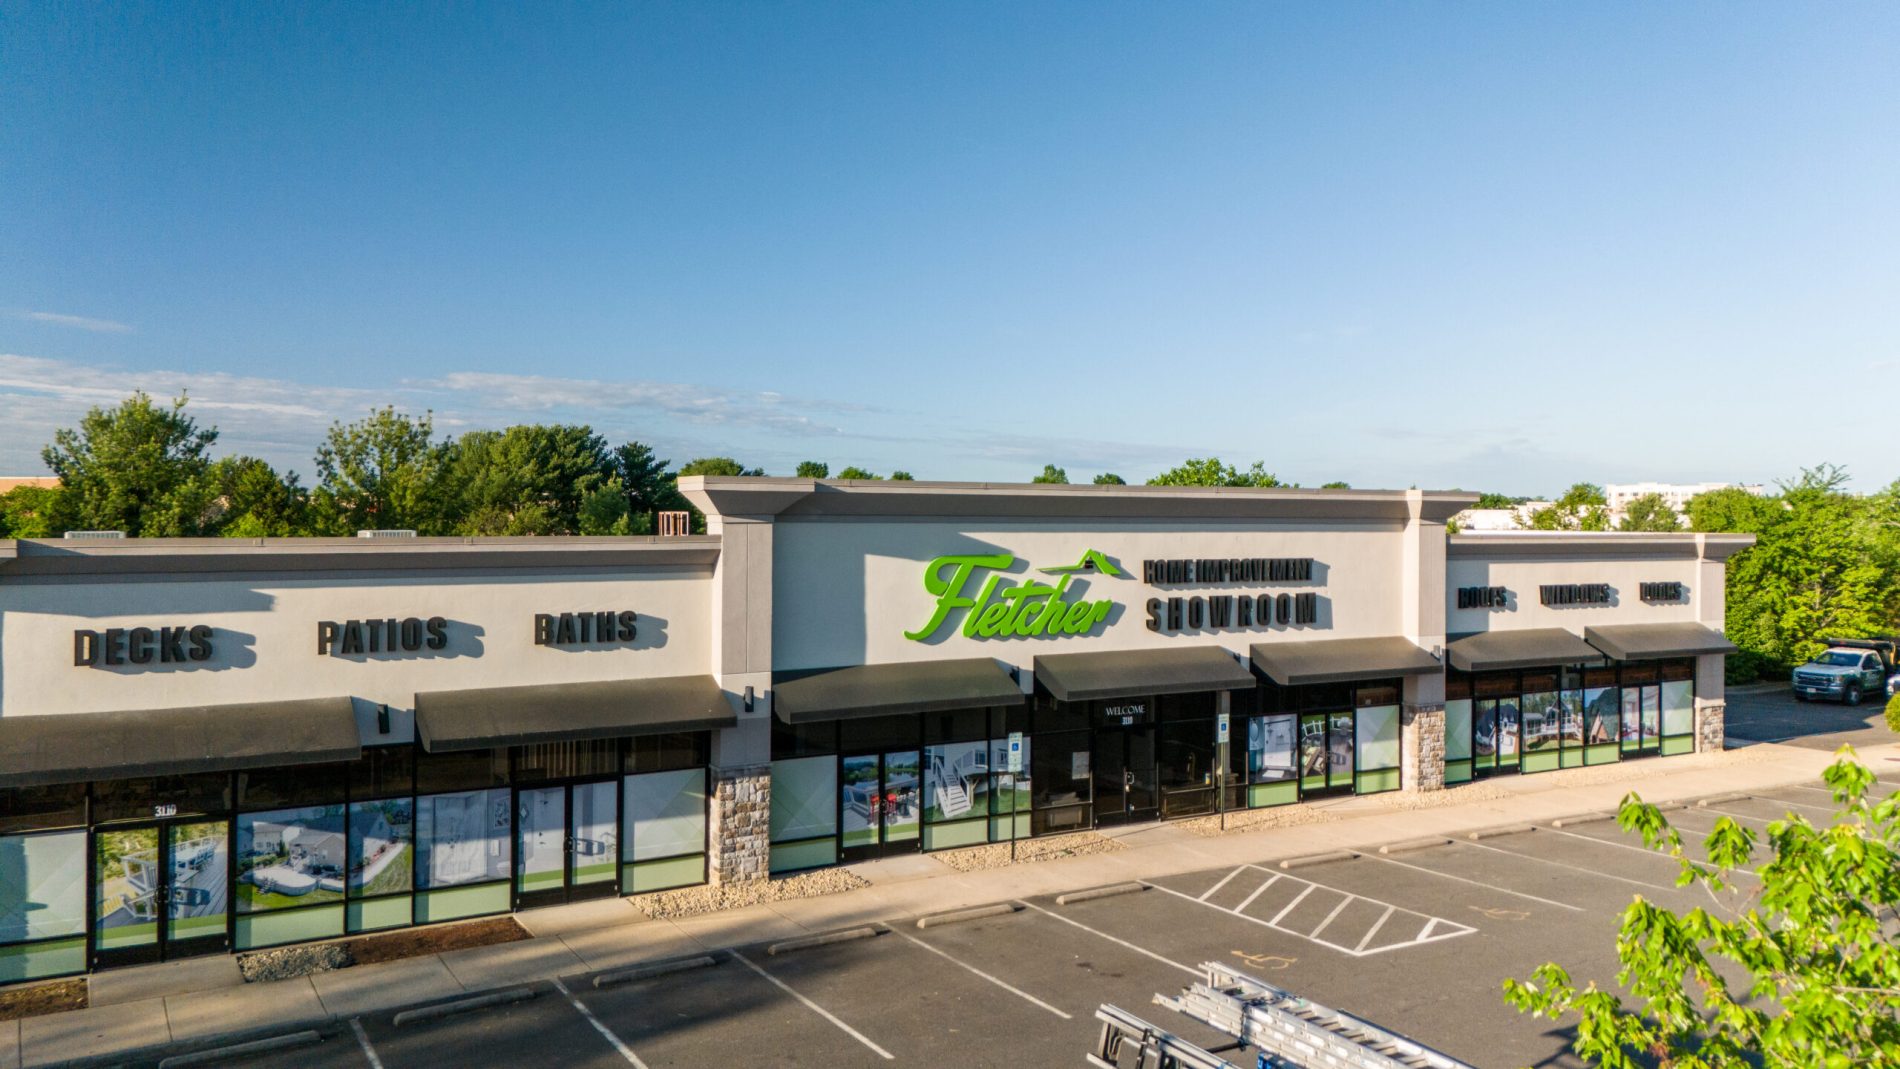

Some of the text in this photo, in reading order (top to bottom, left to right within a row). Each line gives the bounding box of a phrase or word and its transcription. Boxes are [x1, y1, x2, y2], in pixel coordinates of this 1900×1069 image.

[1143, 558, 1314, 584] HOME IMPROVEMENT
[903, 554, 1112, 640] Fletcher
[1458, 586, 1508, 609] ROOFS
[1539, 583, 1611, 605] WINDOWS
[535, 610, 637, 645] BATHS
[1145, 592, 1317, 632] SHOWROOM
[74, 625, 213, 667] DECKS
[317, 616, 448, 656] PATIOS
[1105, 704, 1146, 716] WELCOME
